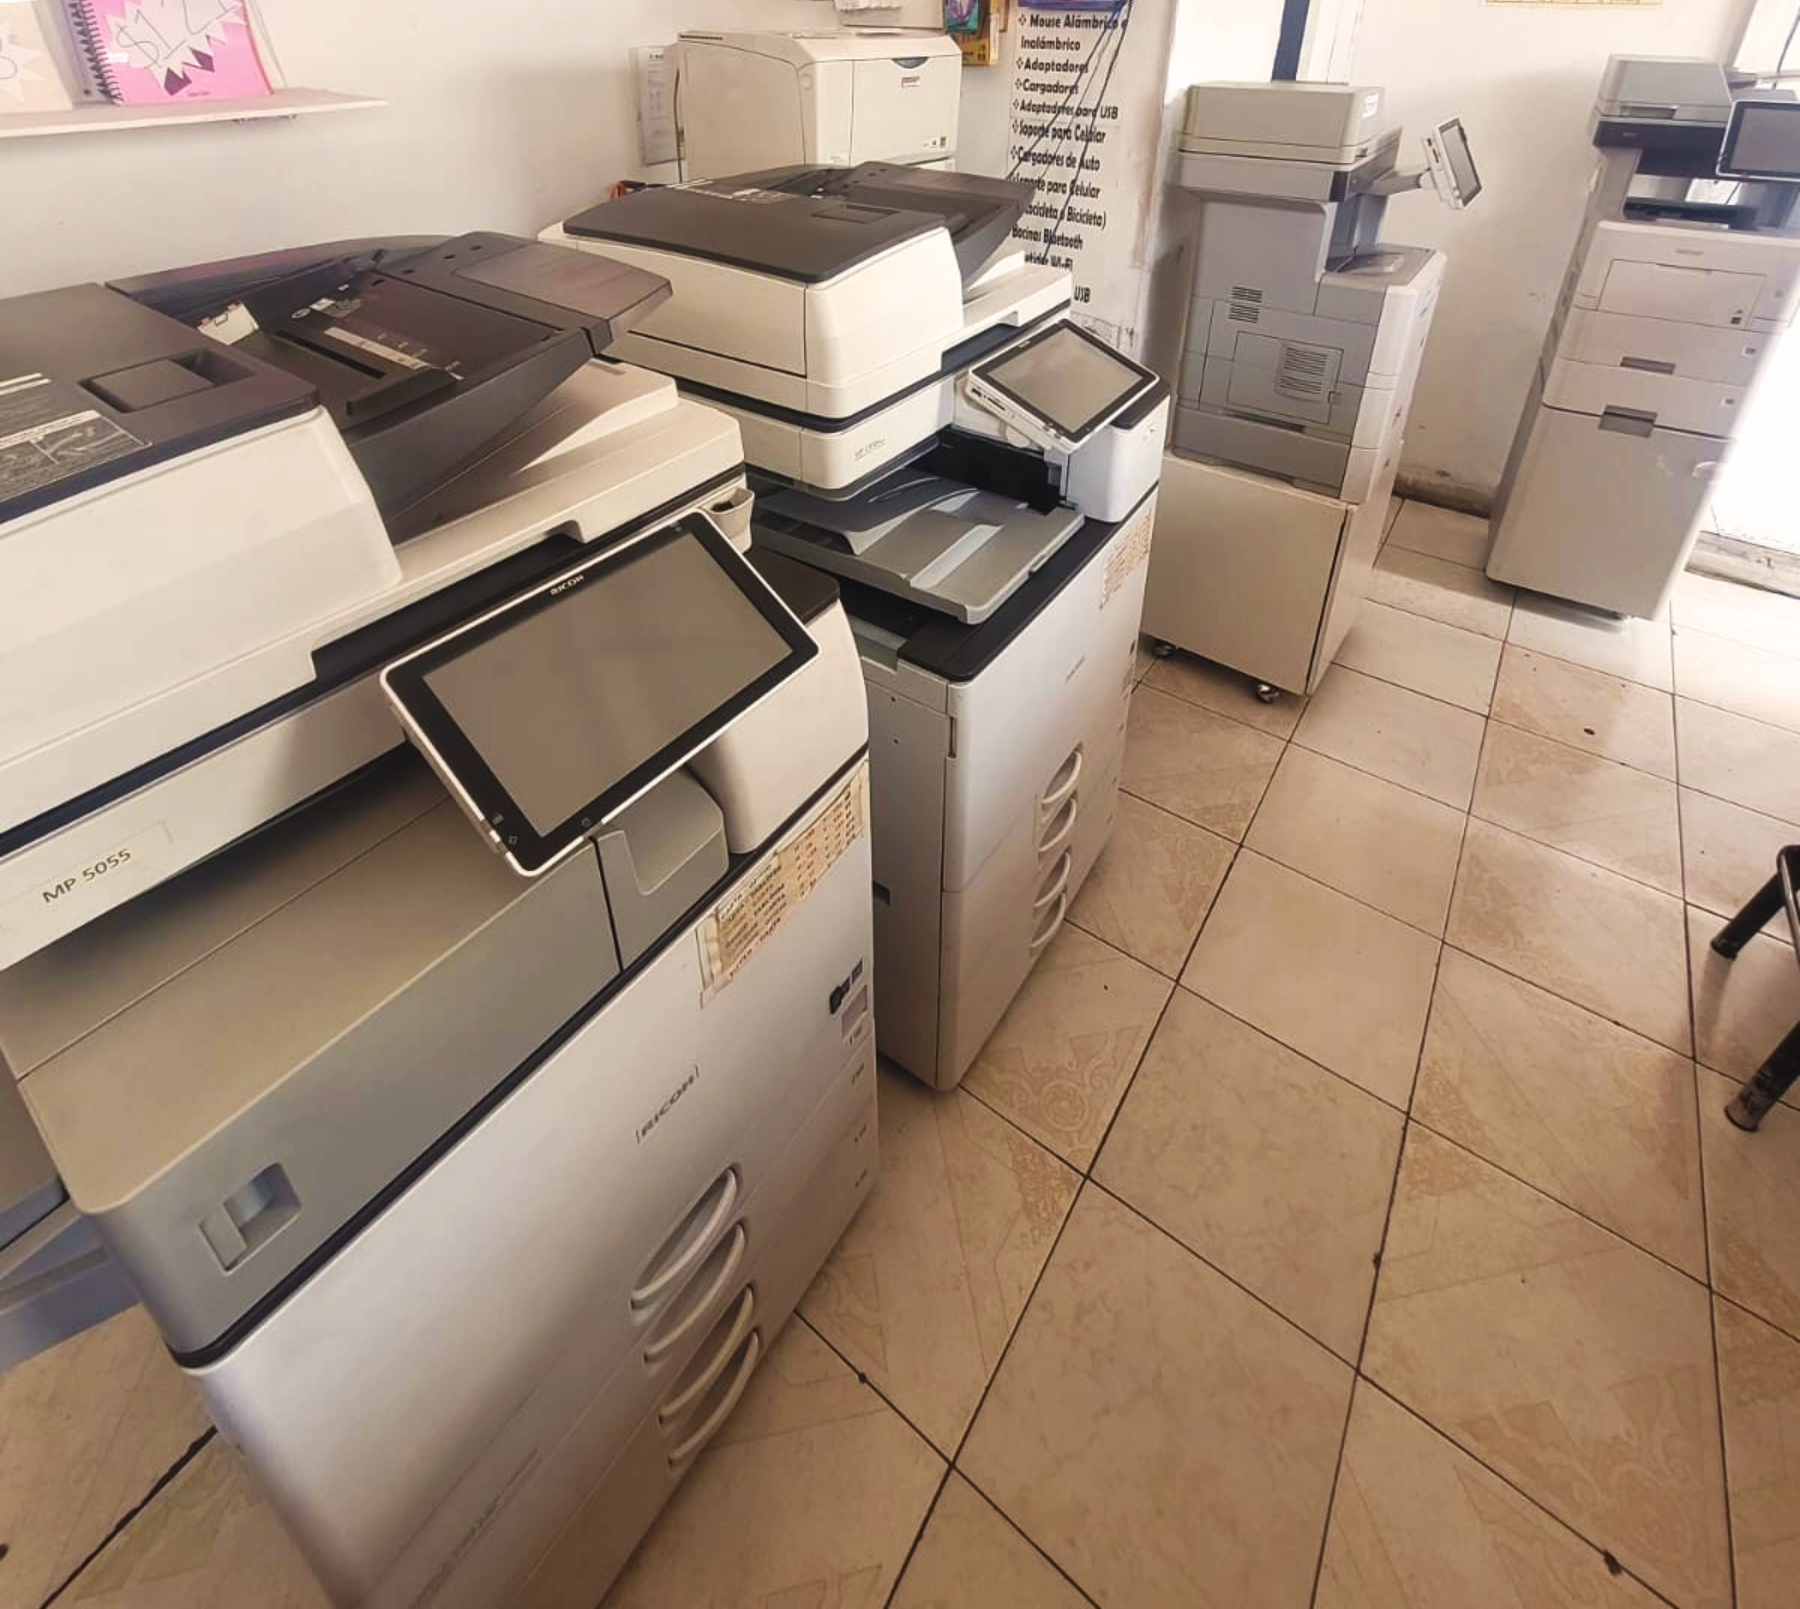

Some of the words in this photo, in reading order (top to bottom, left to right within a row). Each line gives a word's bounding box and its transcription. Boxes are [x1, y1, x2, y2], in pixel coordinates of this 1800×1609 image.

[1030, 14, 1060, 28] Mouse
[1021, 36, 1081, 51] Inalámbrico
[1024, 58, 1088, 73] Adaptadores
[1022, 79, 1079, 94] Cargadores
[1020, 99, 1074, 115] Adaptadores
[1075, 106, 1097, 118] para
[1100, 106, 1118, 120] USB
[1051, 127, 1072, 142] para
[1066, 151, 1077, 168] de
[1047, 180, 1067, 195] para
[1043, 228, 1083, 250] Bluetooth
[1074, 286, 1091, 303] USB
[42, 878, 77, 903] MP
[82, 848, 131, 882] 5055
[640, 1073, 695, 1138] RICOH
